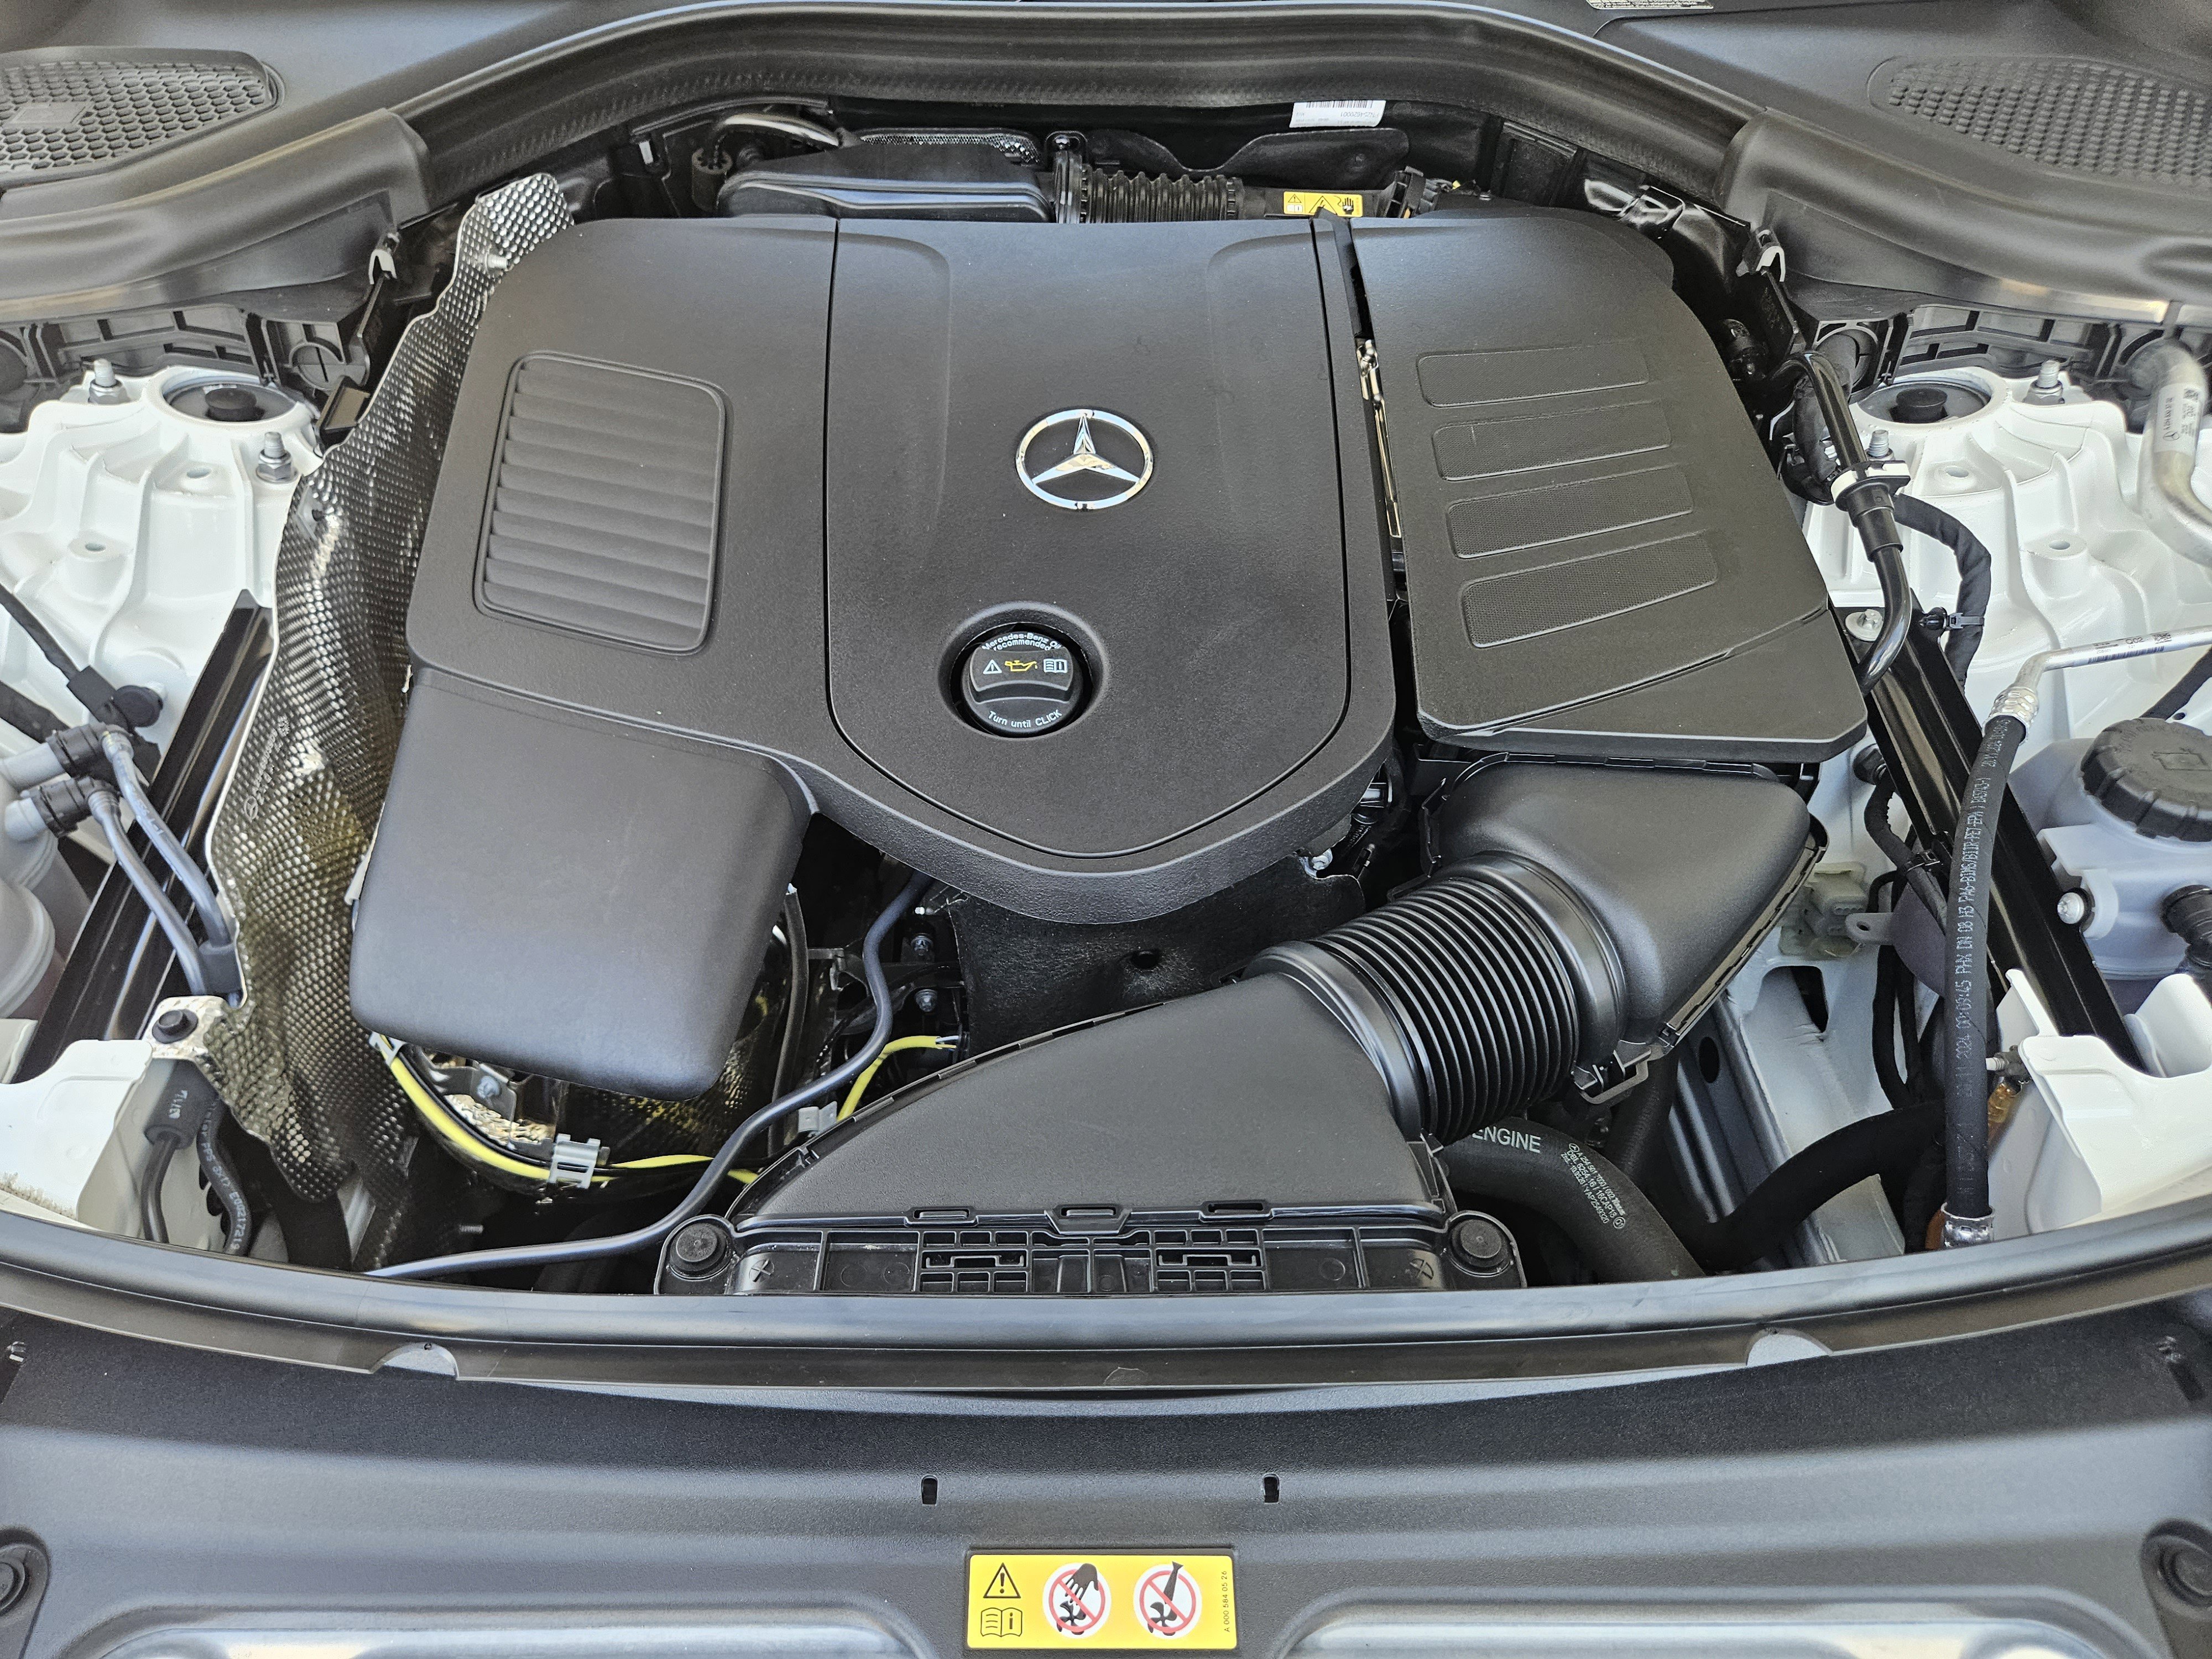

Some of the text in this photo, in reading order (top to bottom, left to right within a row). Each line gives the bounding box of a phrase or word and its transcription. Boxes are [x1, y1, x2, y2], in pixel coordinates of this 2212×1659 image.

[982, 633, 1062, 650] Mercedes-Benz Oil
[993, 639, 1051, 651] recommended
[988, 709, 1062, 728] Turn until CLICK
[1472, 1126, 1541, 1154] ENGINE
[1567, 1150, 1578, 1165] DBL
[1580, 1155, 1590, 1165] 254
[1221, 1571, 1227, 1579] 26
[1222, 1582, 1228, 1592] 05
